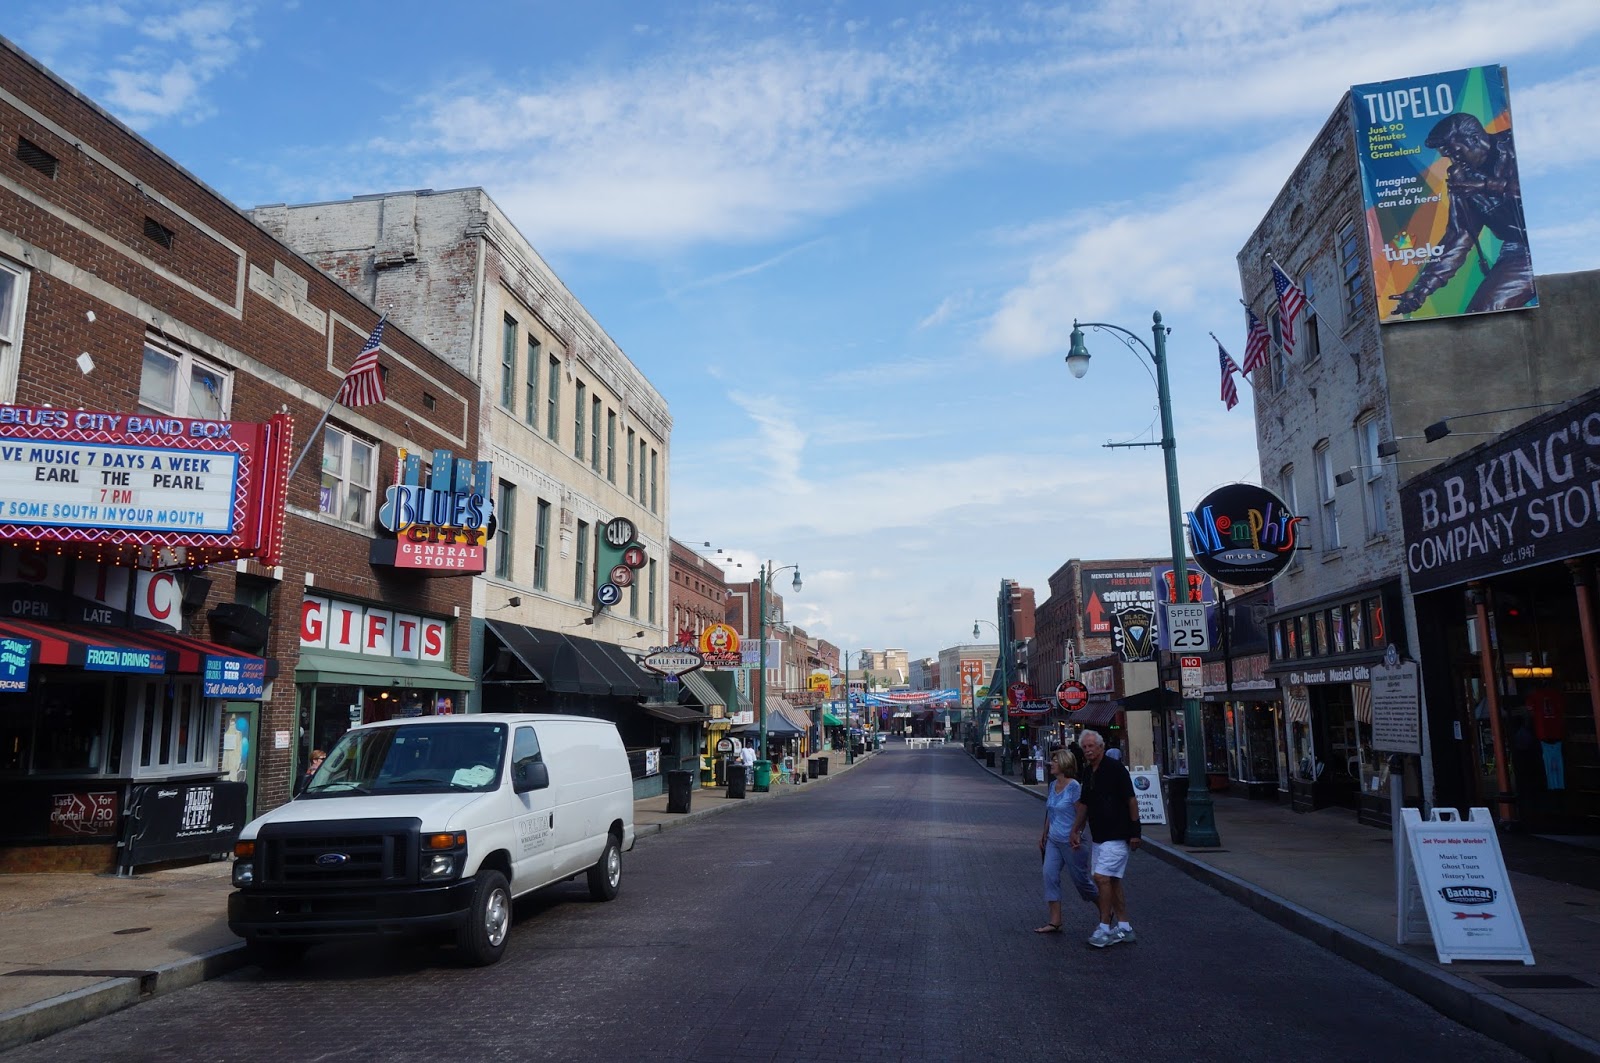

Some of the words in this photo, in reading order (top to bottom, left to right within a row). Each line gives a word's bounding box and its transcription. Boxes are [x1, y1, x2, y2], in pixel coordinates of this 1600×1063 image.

[1363, 84, 1454, 124] TUPELO
[1368, 126, 1387, 135] Just
[1389, 123, 1404, 131] 90
[1369, 133, 1407, 143] Minutes
[1369, 143, 1392, 151] from
[1370, 145, 1421, 160] Graceland
[1376, 176, 1417, 187] Imagine
[1377, 188, 1402, 197] what
[1404, 186, 1423, 197] you
[1399, 197, 1412, 205] do
[1414, 193, 1442, 204] here!
[1382, 243, 1445, 266] tupelo
[0, 407, 69, 428] BLUES
[74, 412, 122, 431] CITY
[127, 417, 184, 436] BAND
[190, 422, 232, 439] BOX
[1, 446, 23, 461] VE
[29, 448, 80, 465] MUSIC
[87, 452, 96, 466] 7
[102, 452, 145, 469] DAYS
[151, 456, 162, 470] A
[168, 457, 211, 472] WEEK
[35, 466, 79, 483] EARL
[101, 471, 130, 486] THE
[153, 474, 204, 490] PEARL
[100, 489, 107, 503] 7
[112, 490, 132, 504] PM
[9, 501, 49, 517] SOME
[53, 503, 99, 520] SOUTH
[157, 510, 205, 525] MOUTH
[394, 486, 484, 533] BLUES
[407, 525, 484, 546] CITY
[607, 520, 632, 545] CLUB
[1407, 507, 1518, 573] COMPANY
[402, 544, 478, 558] GENERAL
[1518, 544, 1536, 561] 1947
[414, 556, 465, 567] STORE
[630, 552, 638, 564] 1
[615, 570, 627, 582] 5
[602, 588, 614, 600] 2
[1102, 590, 1138, 601] COYOTE
[12, 600, 49, 617] OPEN
[83, 608, 112, 624] LATE
[1171, 609, 1203, 618] SPEED
[301, 600, 442, 656] GIFTS
[1123, 619, 1150, 627] DIAMOND
[1175, 619, 1199, 627] LIMIT
[1173, 629, 1205, 647] 25
[1, 653, 26, 667] SHARE
[87, 649, 120, 666] FROZEN
[121, 652, 150, 667] DRINKS
[1184, 658, 1198, 667] NO
[9, 665, 17, 675] IT
[225, 661, 240, 670] COLD
[224, 671, 239, 680] BEER
[1290, 672, 1300, 684] CDs
[1303, 670, 1326, 683] Records
[1329, 667, 1354, 681] Musical
[1354, 666, 1370, 680] Gifts
[1058, 691, 1088, 700] RESTAURANT
[55, 795, 73, 806] Last
[98, 795, 113, 805] for
[188, 790, 211, 806] BLUES
[96, 808, 113, 820] 30
[1446, 888, 1492, 898] Backbeat
